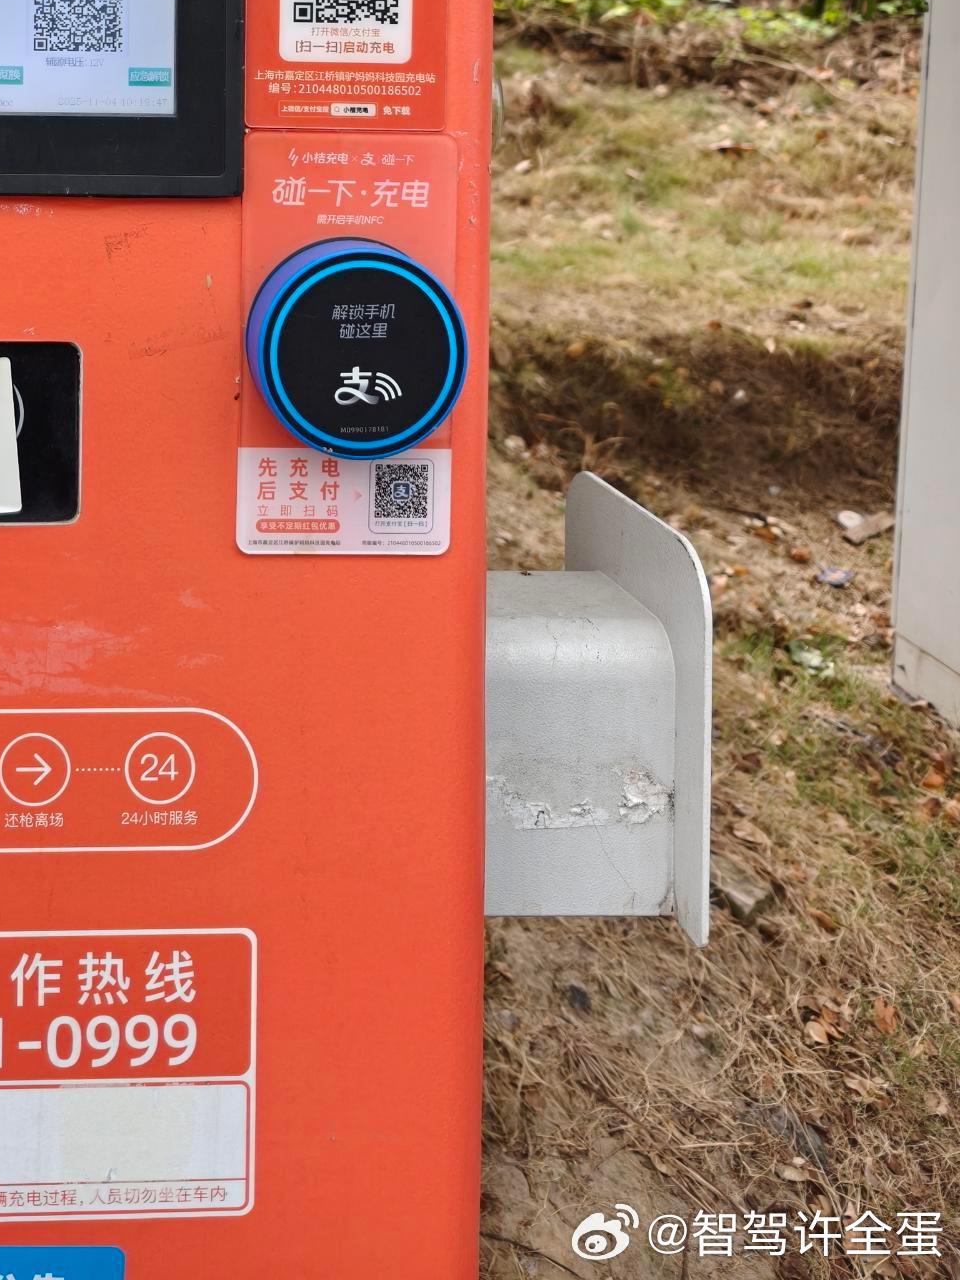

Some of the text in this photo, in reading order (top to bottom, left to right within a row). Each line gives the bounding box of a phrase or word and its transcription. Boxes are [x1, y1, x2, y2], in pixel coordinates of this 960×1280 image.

[311, 27, 381, 38] 打开微信/支付宝
[295, 40, 395, 54] [扫一扫]启动充电
[254, 70, 436, 84] 上海市嘉定区江桥镇驴妈妈科技园充电站
[383, 105, 411, 116] 免下载
[302, 152, 349, 165] 小桔充电
[381, 153, 415, 166] 碰一下
[332, 303, 395, 320] 解锁手机
[339, 322, 388, 339] 碰这里
[258, 457, 340, 477] 先充电
[257, 481, 340, 501] 后支付
[257, 504, 338, 517] 立即扫码
[139, 754, 179, 782] 24
[4, 812, 65, 829] 还枪离场
[121, 810, 199, 827] 24小时服务
